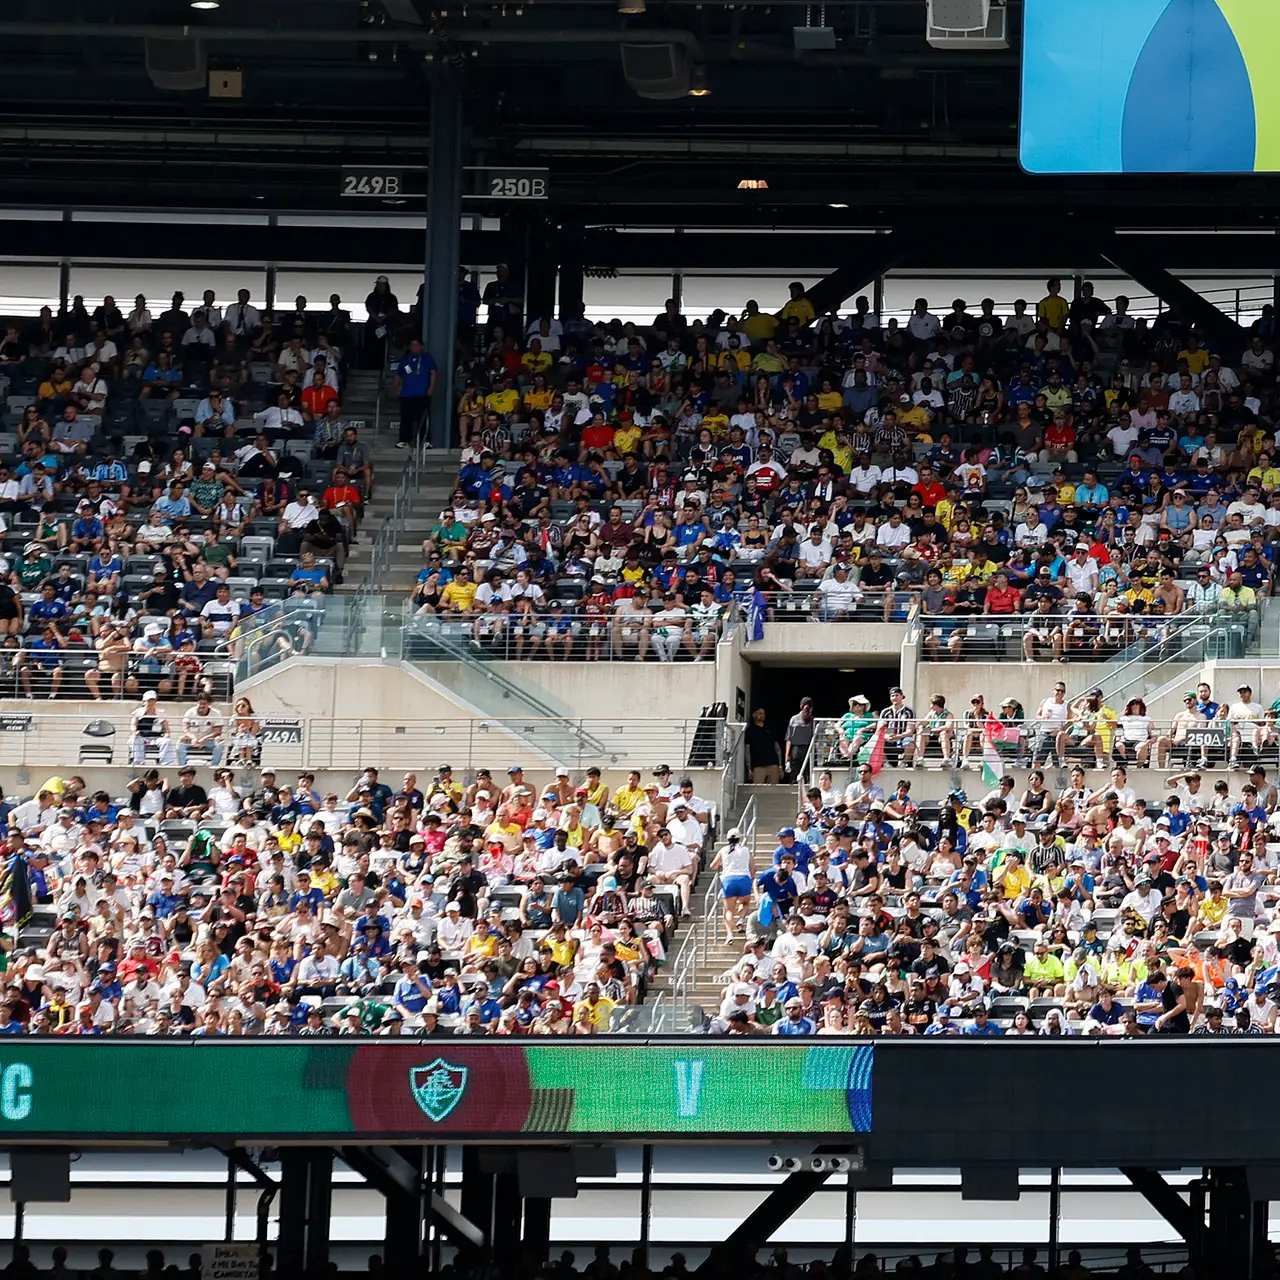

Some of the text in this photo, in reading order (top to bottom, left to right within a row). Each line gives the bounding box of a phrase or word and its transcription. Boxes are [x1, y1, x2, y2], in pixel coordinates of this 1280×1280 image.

[344, 176, 399, 195] 249B
[491, 178, 545, 196] 250B
[263, 730, 299, 744] 249A
[1187, 733, 1222, 746] 250A
[0, 1062, 34, 1121] C
[674, 1059, 704, 1118] V
